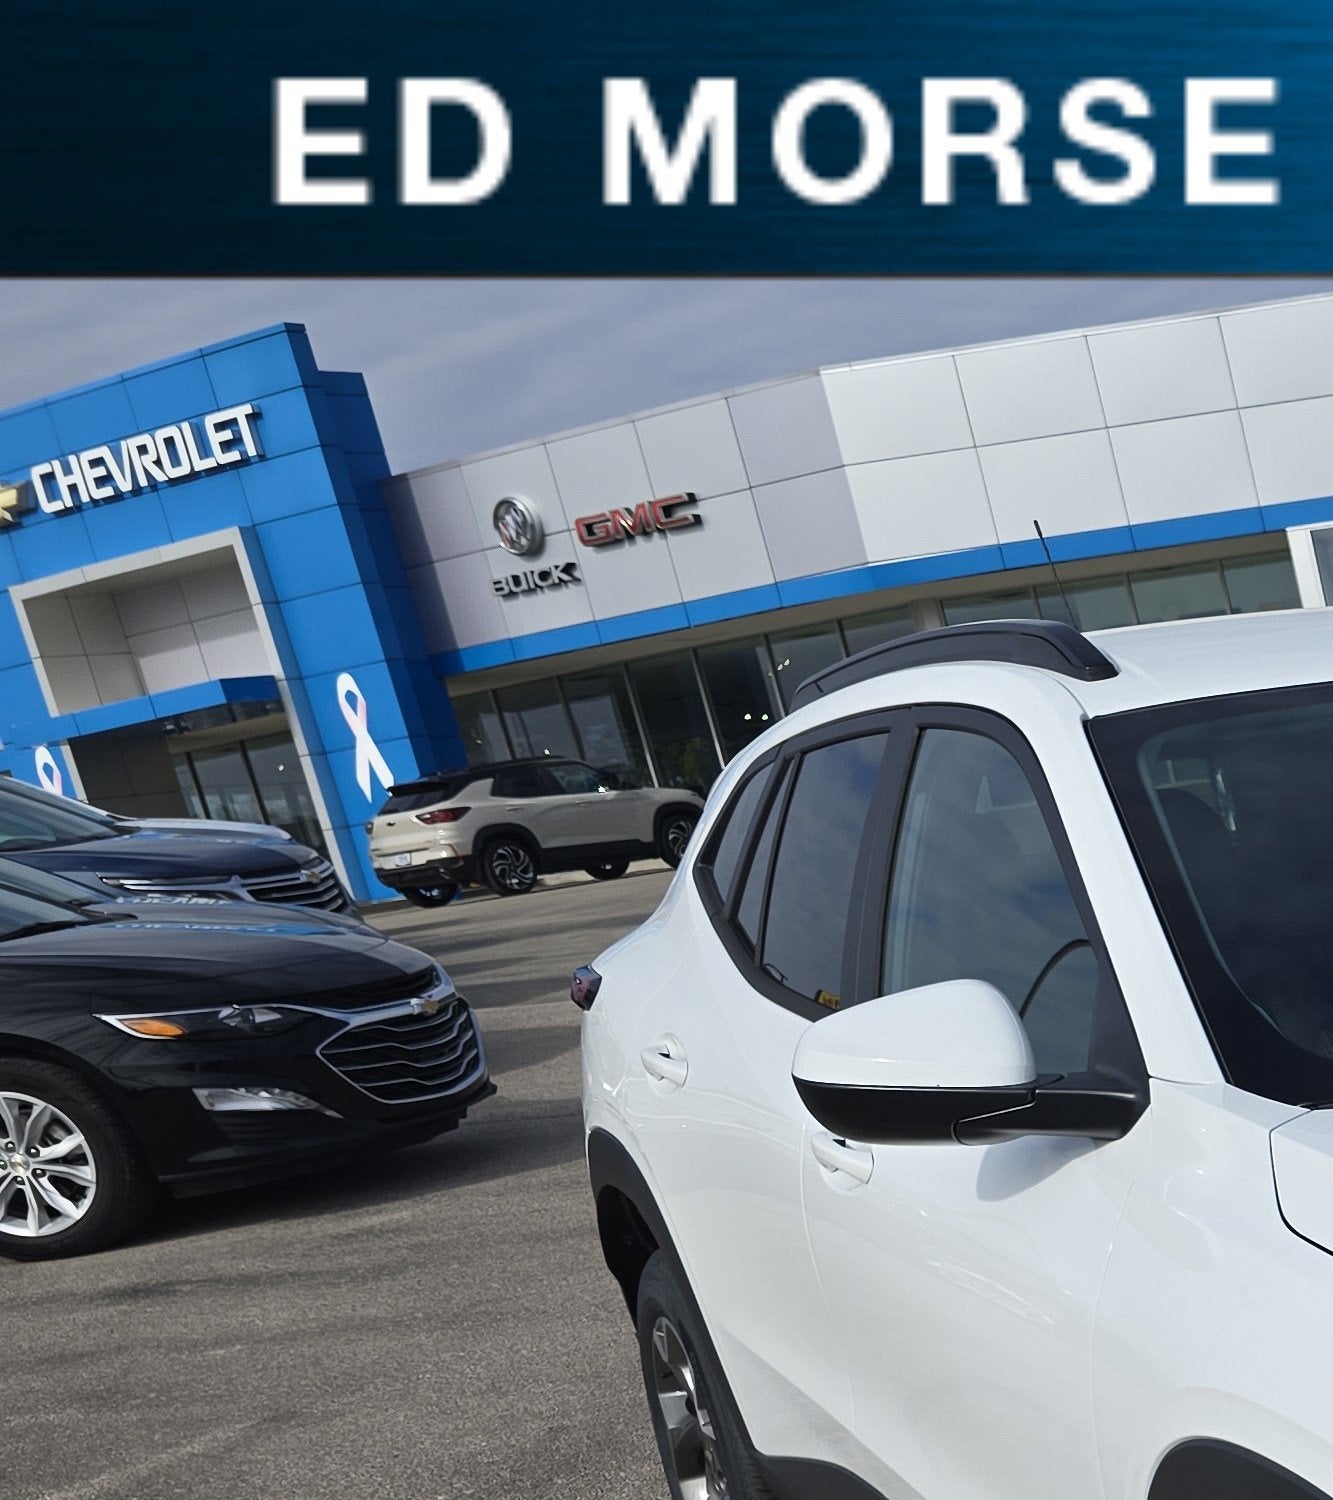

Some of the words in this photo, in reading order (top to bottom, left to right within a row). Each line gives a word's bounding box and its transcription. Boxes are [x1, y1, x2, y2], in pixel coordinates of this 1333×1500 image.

[30, 402, 261, 515] CHEVROLET
[575, 492, 699, 548] GMC
[492, 561, 582, 597] BUICK
